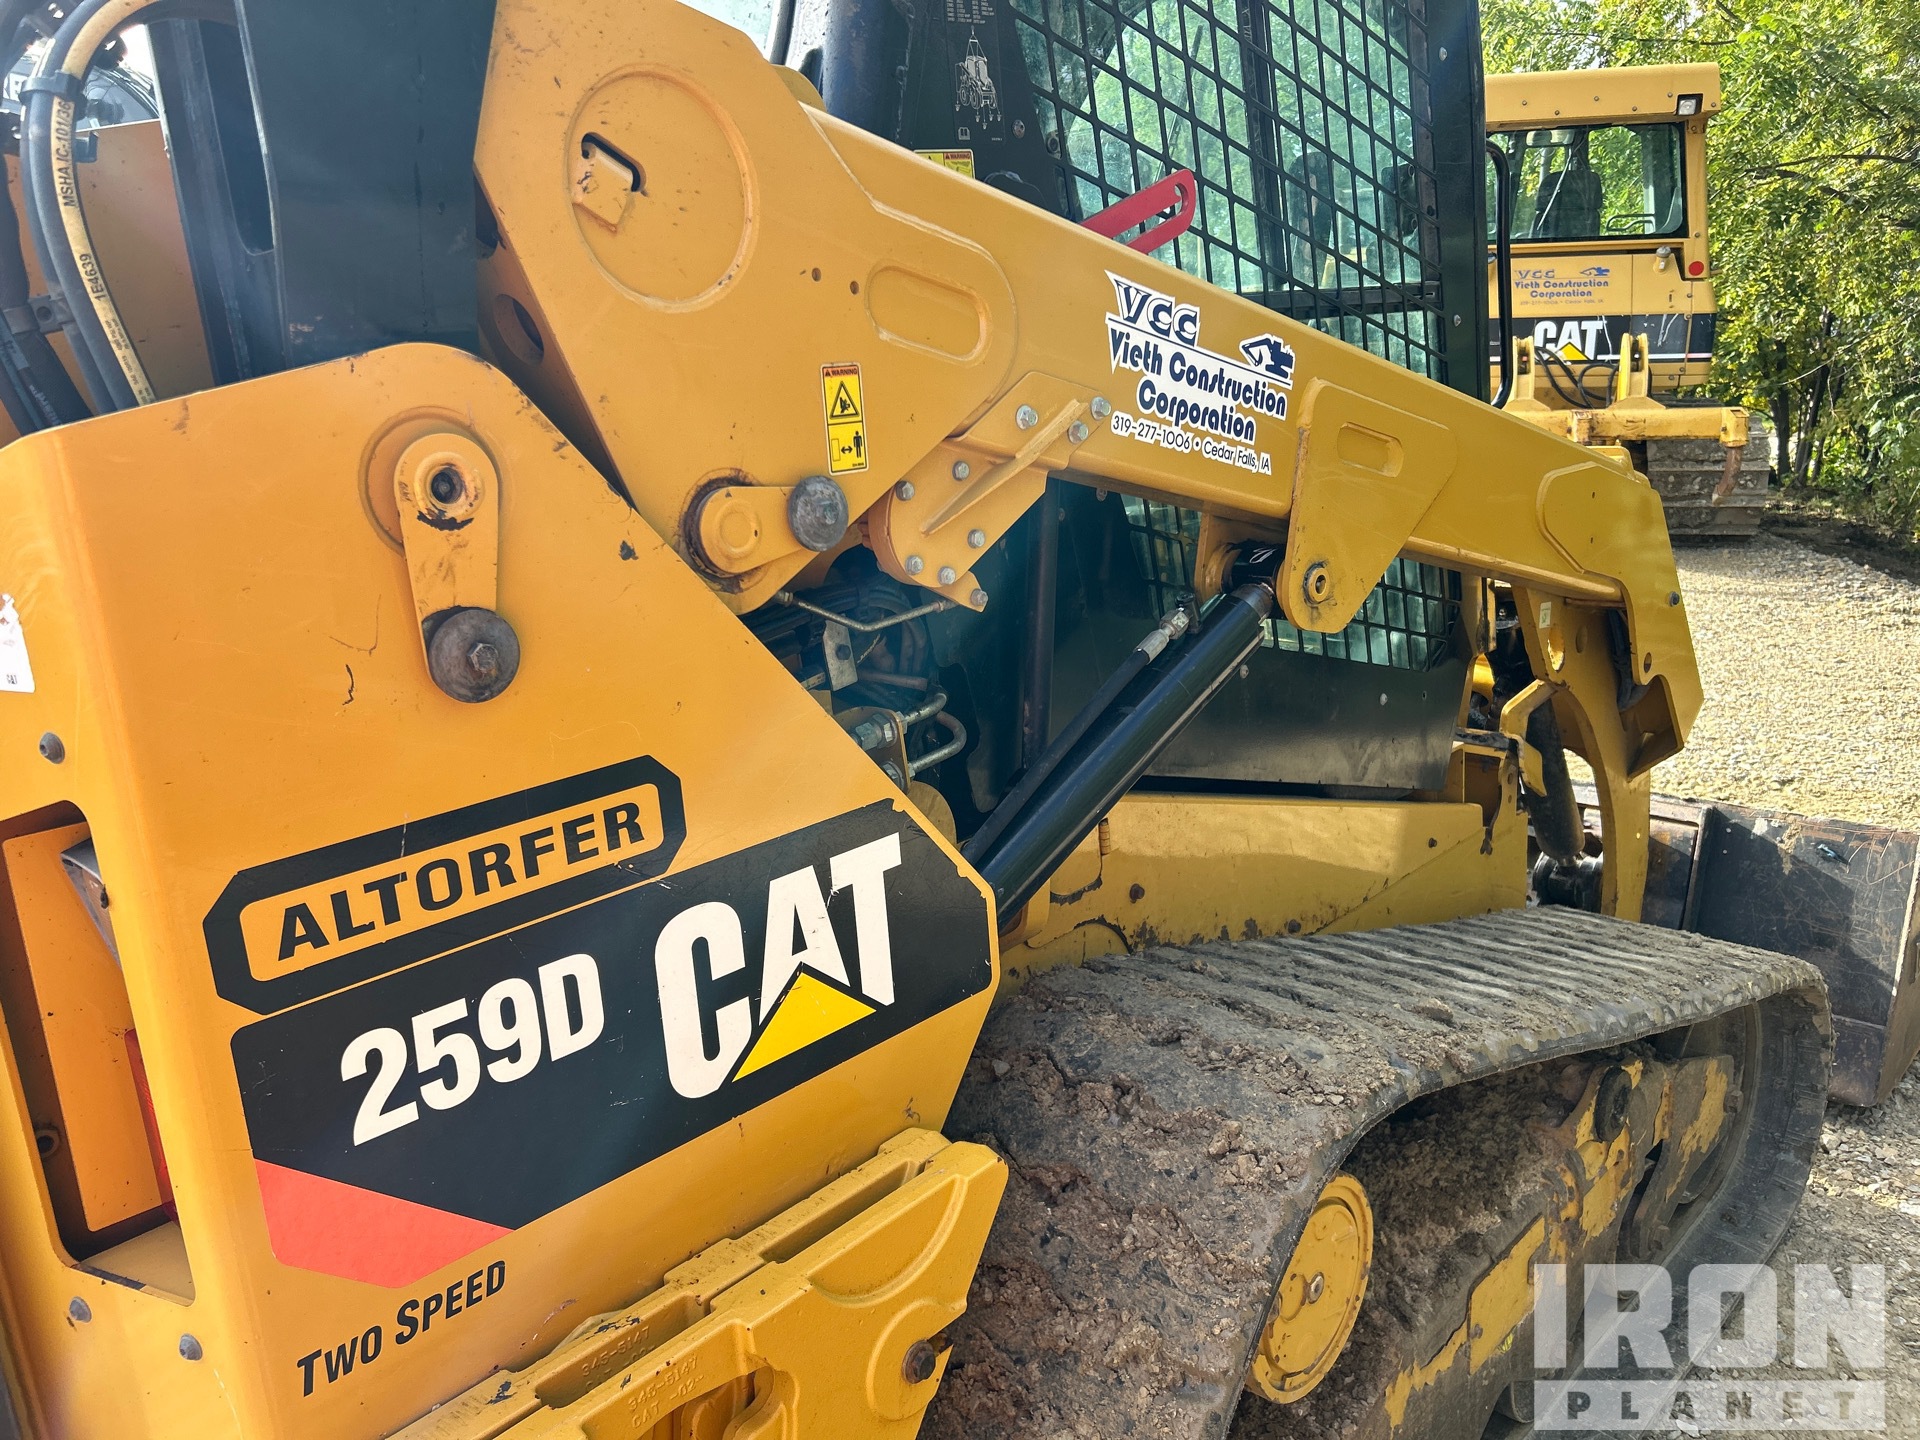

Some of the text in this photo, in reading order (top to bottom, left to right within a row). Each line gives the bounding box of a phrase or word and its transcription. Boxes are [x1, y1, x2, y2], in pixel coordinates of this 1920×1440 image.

[57, 167, 76, 207] MSHA
[79, 253, 106, 301] 1E4639
[1515, 279, 1609, 289] Vieth Construction
[1530, 289, 1592, 299] Corporation
[1114, 279, 1198, 347] VCC
[1534, 320, 1603, 361] CAT
[831, 368, 858, 376] WARNING
[1110, 328, 1286, 417] Vieth Construction
[1139, 380, 1255, 442] Corporation
[1113, 415, 1270, 472] 319-277-1006 Cedar Falls, IA
[277, 801, 645, 962] ALTORFER
[654, 831, 902, 1099] CAT
[340, 953, 605, 1147] 259D
[582, 1326, 650, 1376] 345-5147
[628, 1356, 698, 1411] 345-5147
[632, 1401, 660, 1428] CAT
